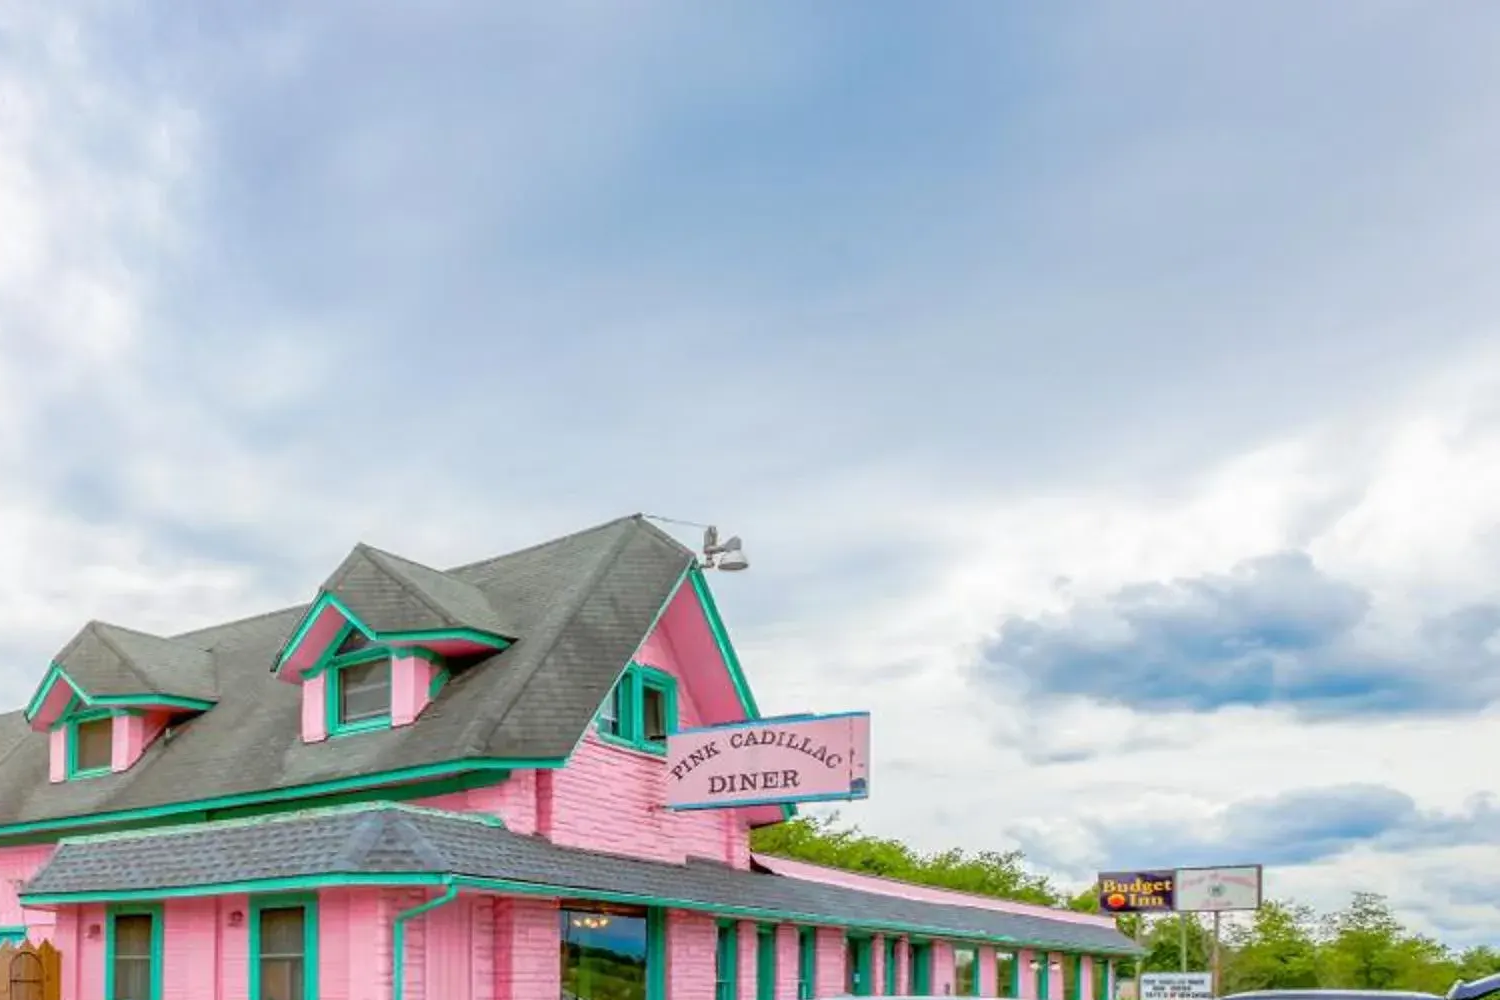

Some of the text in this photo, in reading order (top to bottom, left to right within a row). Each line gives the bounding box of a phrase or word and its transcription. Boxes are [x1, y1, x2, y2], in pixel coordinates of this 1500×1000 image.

[671, 730, 842, 781] PINK CADILLAC
[708, 769, 800, 794] DINER
[1103, 877, 1172, 895] Budget
[1129, 894, 1163, 906] Inn
